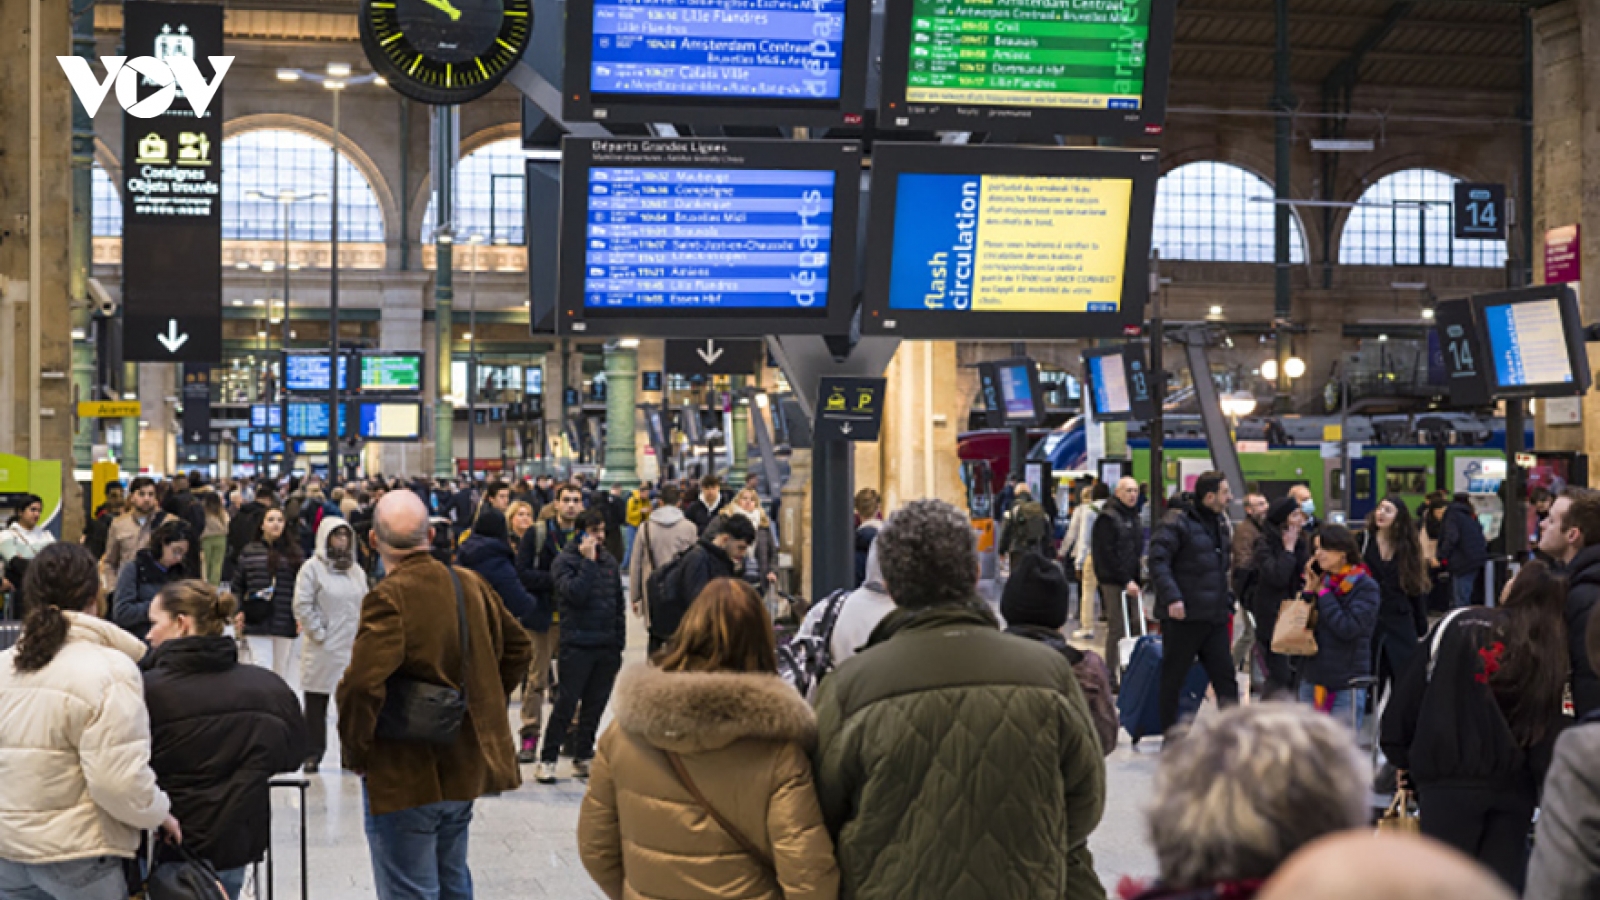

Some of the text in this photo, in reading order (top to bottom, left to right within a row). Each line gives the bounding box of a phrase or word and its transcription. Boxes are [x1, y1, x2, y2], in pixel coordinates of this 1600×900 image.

[682, 9, 710, 23] Lille
[713, 9, 768, 25] Flandres
[994, 21, 1020, 33] Creil
[680, 37, 756, 52] Amsterdam
[680, 66, 719, 80] Calais
[721, 67, 749, 80] Ville
[993, 62, 1043, 75] Dortmund
[592, 140, 727, 155] Départs Grandes Lignes
[141, 165, 206, 182] Consignes
[127, 178, 219, 194] Objets trouvés
[723, 213, 747, 223] Midi
[1465, 202, 1498, 228] 14
[790, 189, 823, 307] départs
[949, 181, 978, 310] circulation
[924, 251, 949, 309] flash
[669, 293, 699, 304] Essen
[1449, 340, 1475, 371] 14
